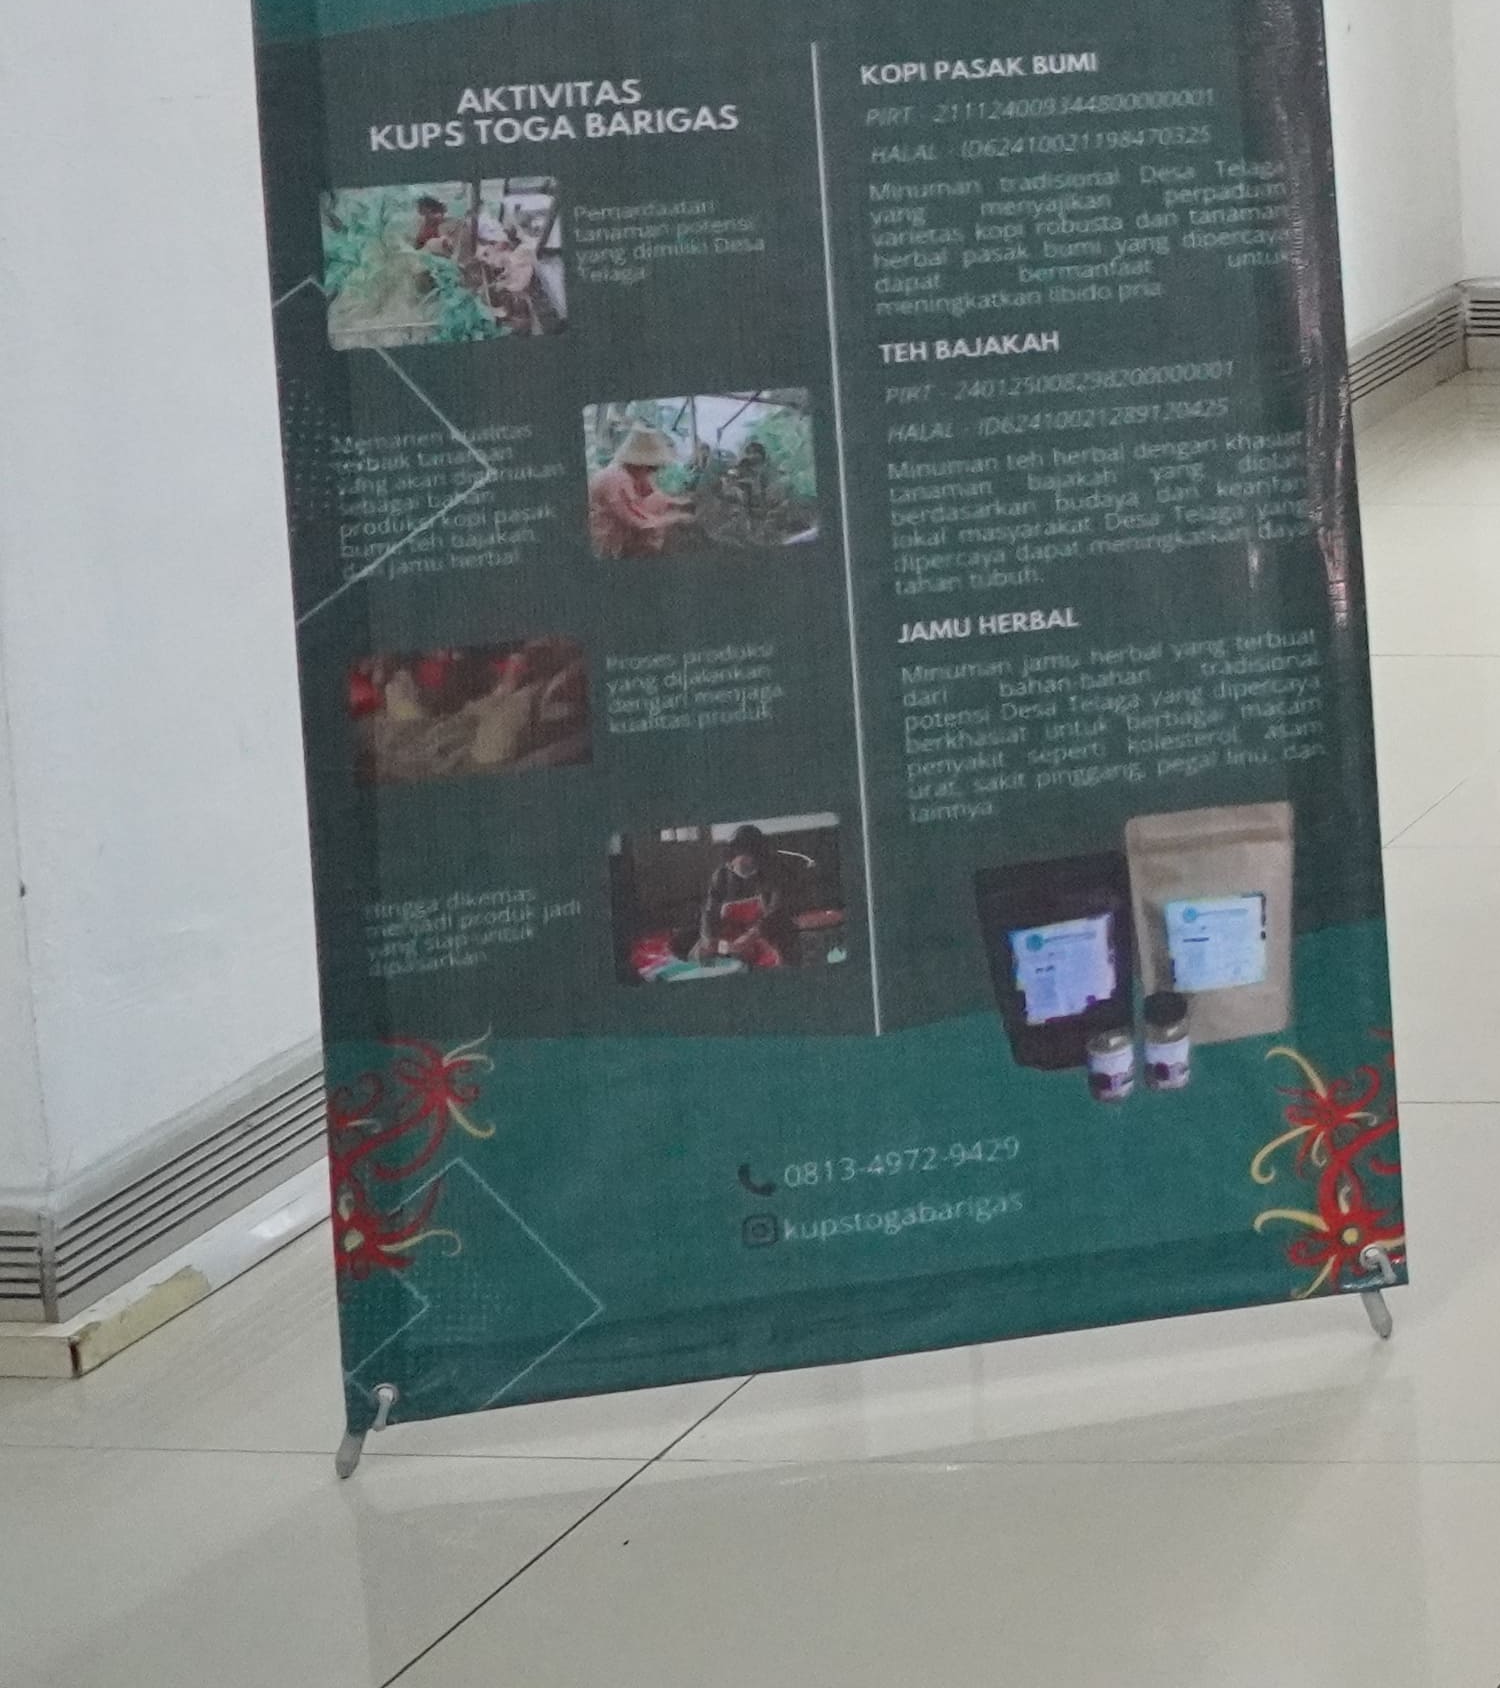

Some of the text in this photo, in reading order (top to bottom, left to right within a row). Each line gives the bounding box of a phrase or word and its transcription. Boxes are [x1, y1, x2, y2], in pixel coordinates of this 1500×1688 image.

[861, 52, 1098, 85] KOPI PASAK BUMI
[457, 78, 642, 114] AKTIVITAS
[370, 105, 739, 152] KUPS TOGA BARIGAS
[871, 144, 938, 164] HALAL
[879, 330, 1059, 364] TEH BAJAKAH
[898, 607, 1080, 643] JAMU HERBAL
[783, 1135, 1020, 1188] 0813-4972-9429
[782, 1192, 1024, 1242] kupstogabarigas
